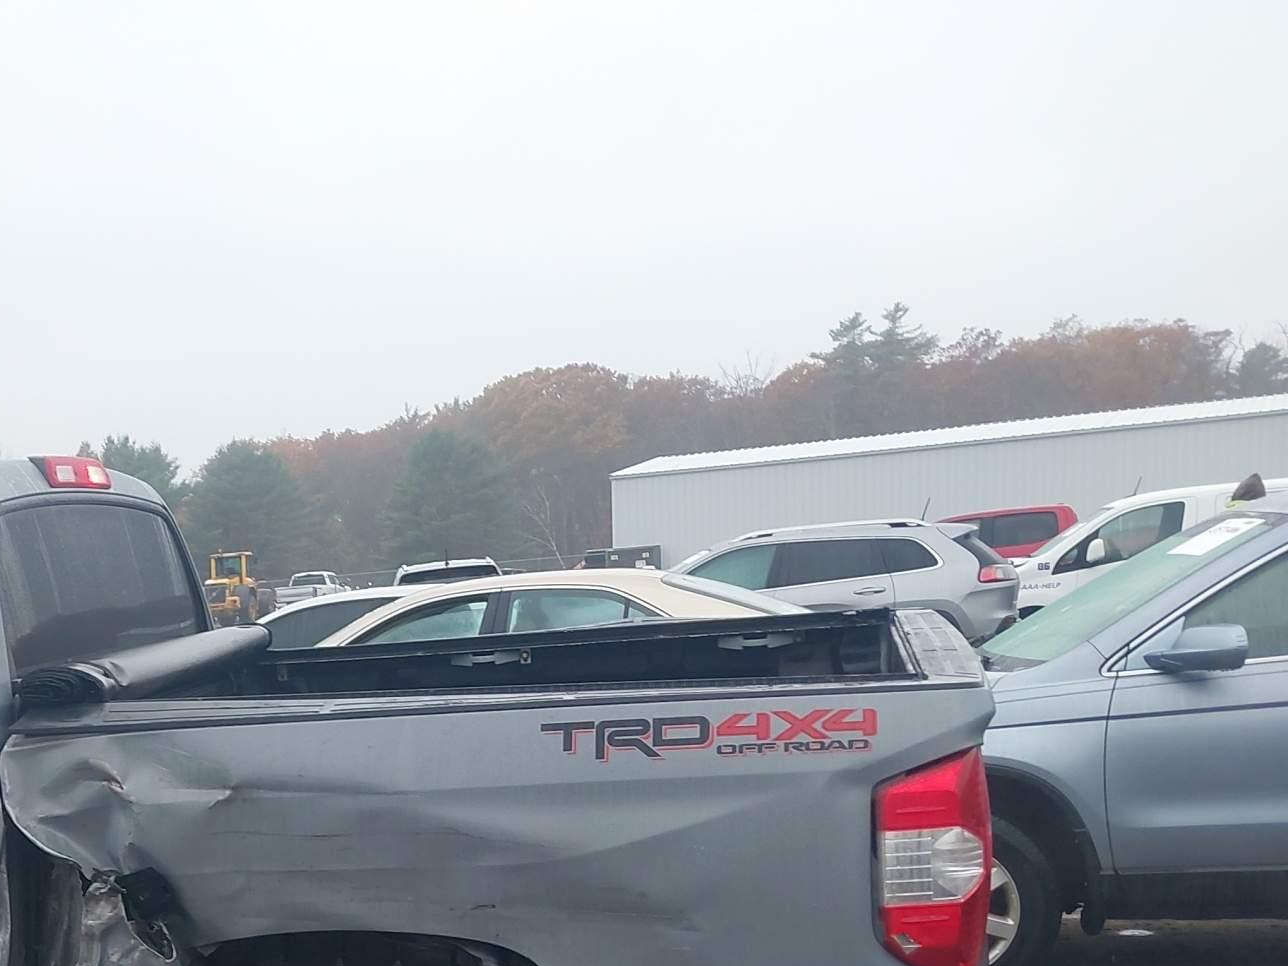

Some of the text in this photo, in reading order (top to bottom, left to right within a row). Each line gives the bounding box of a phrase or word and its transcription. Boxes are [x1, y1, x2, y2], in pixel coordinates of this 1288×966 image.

[540, 708, 877, 762] TRD 4X4
[716, 739, 872, 756] OFF ROAD
